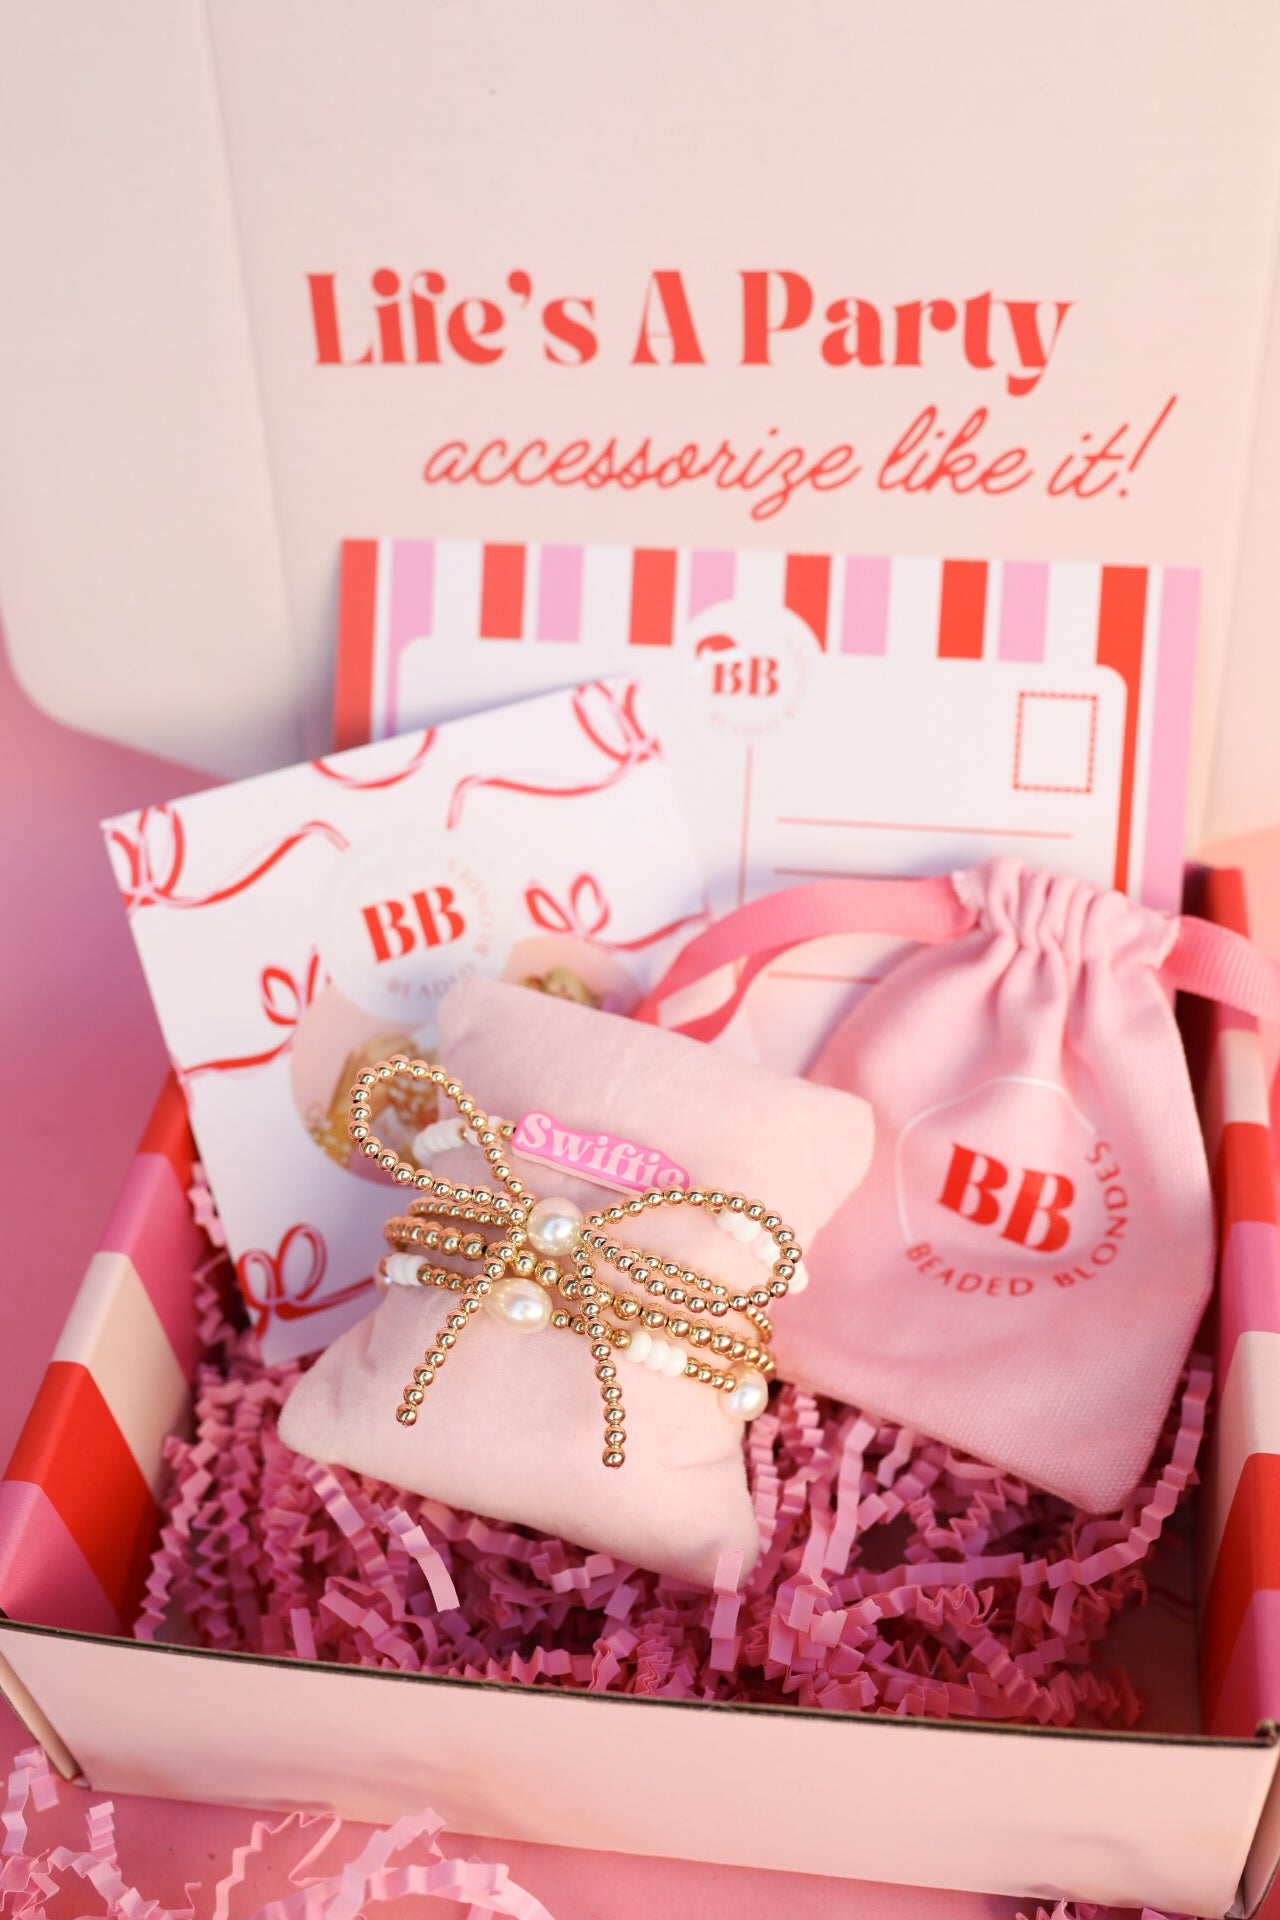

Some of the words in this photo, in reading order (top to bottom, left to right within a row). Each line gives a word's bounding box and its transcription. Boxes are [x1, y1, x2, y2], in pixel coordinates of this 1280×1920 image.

[304, 267, 600, 367] Life's
[630, 269, 707, 366] A
[738, 270, 1078, 398] Party
[423, 426, 863, 522] accessorize
[876, 403, 1036, 496] like
[1046, 394, 1179, 500] it!
[711, 655, 780, 697] BB
[361, 884, 466, 963] BB
[516, 1112, 685, 1190] Swiftie
[937, 1141, 1076, 1255] BB
[905, 1242, 1035, 1298] BEADED
[1052, 1140, 1129, 1289] BLONDES
